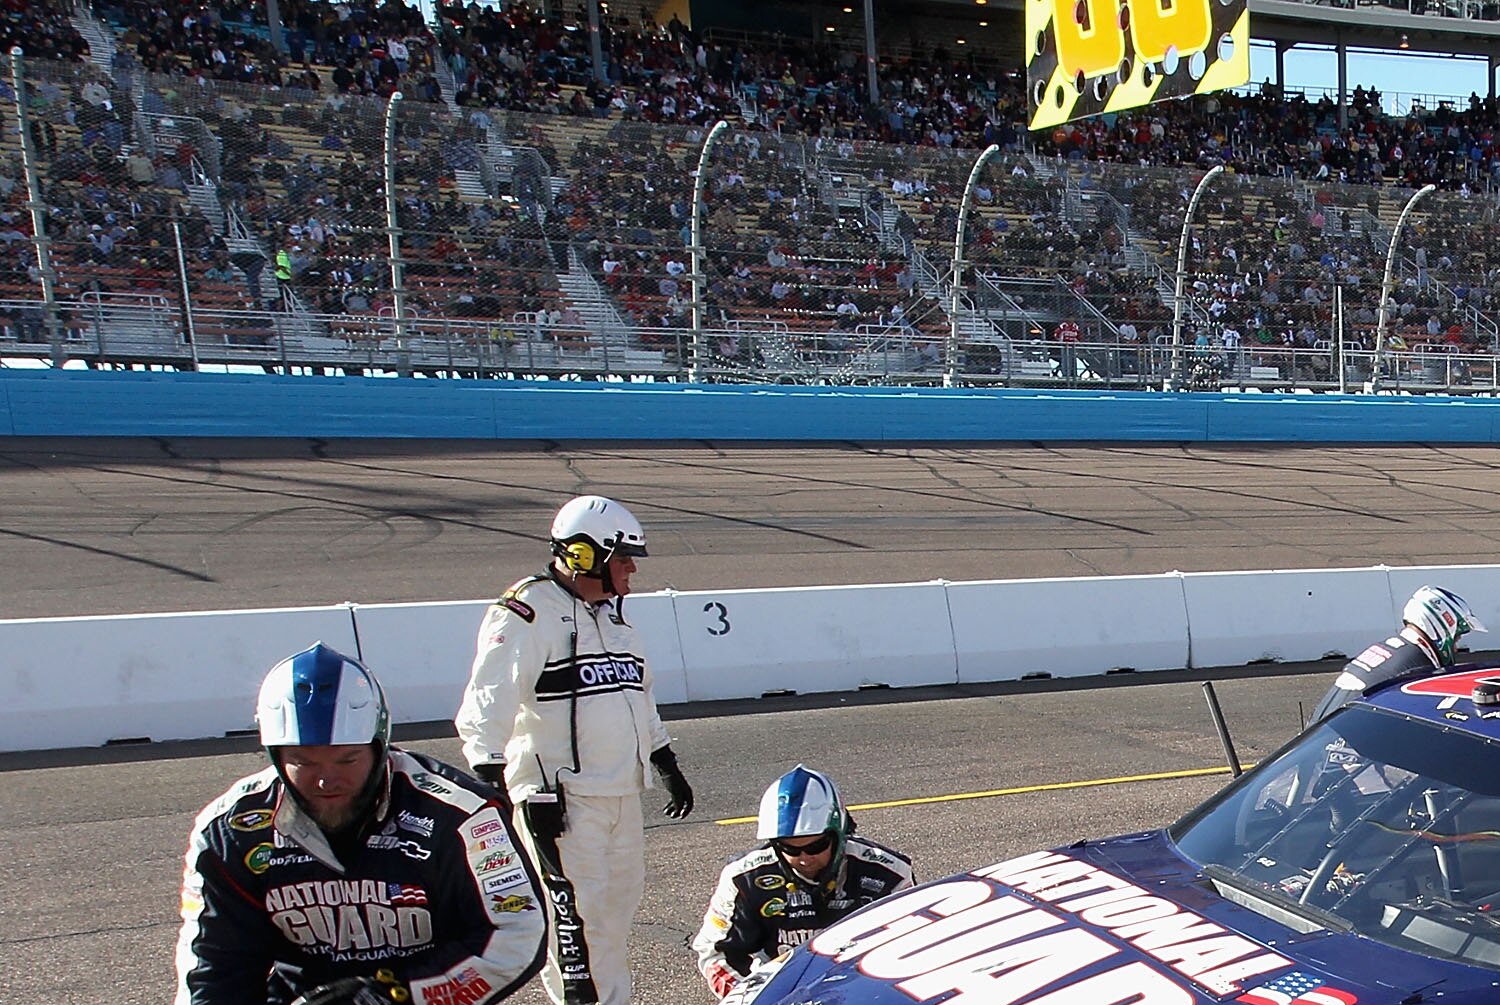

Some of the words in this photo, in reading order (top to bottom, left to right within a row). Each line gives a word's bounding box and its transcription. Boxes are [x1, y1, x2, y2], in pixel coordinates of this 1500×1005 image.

[703, 602, 731, 635] 3
[580, 661, 640, 685] OFFICIA
[266, 879, 392, 912] NATIONAL
[488, 873, 522, 889] SIEMENS
[272, 903, 433, 951] GUARD
[550, 889, 580, 955] Sprint
[970, 850, 1294, 997] NATIONAL
